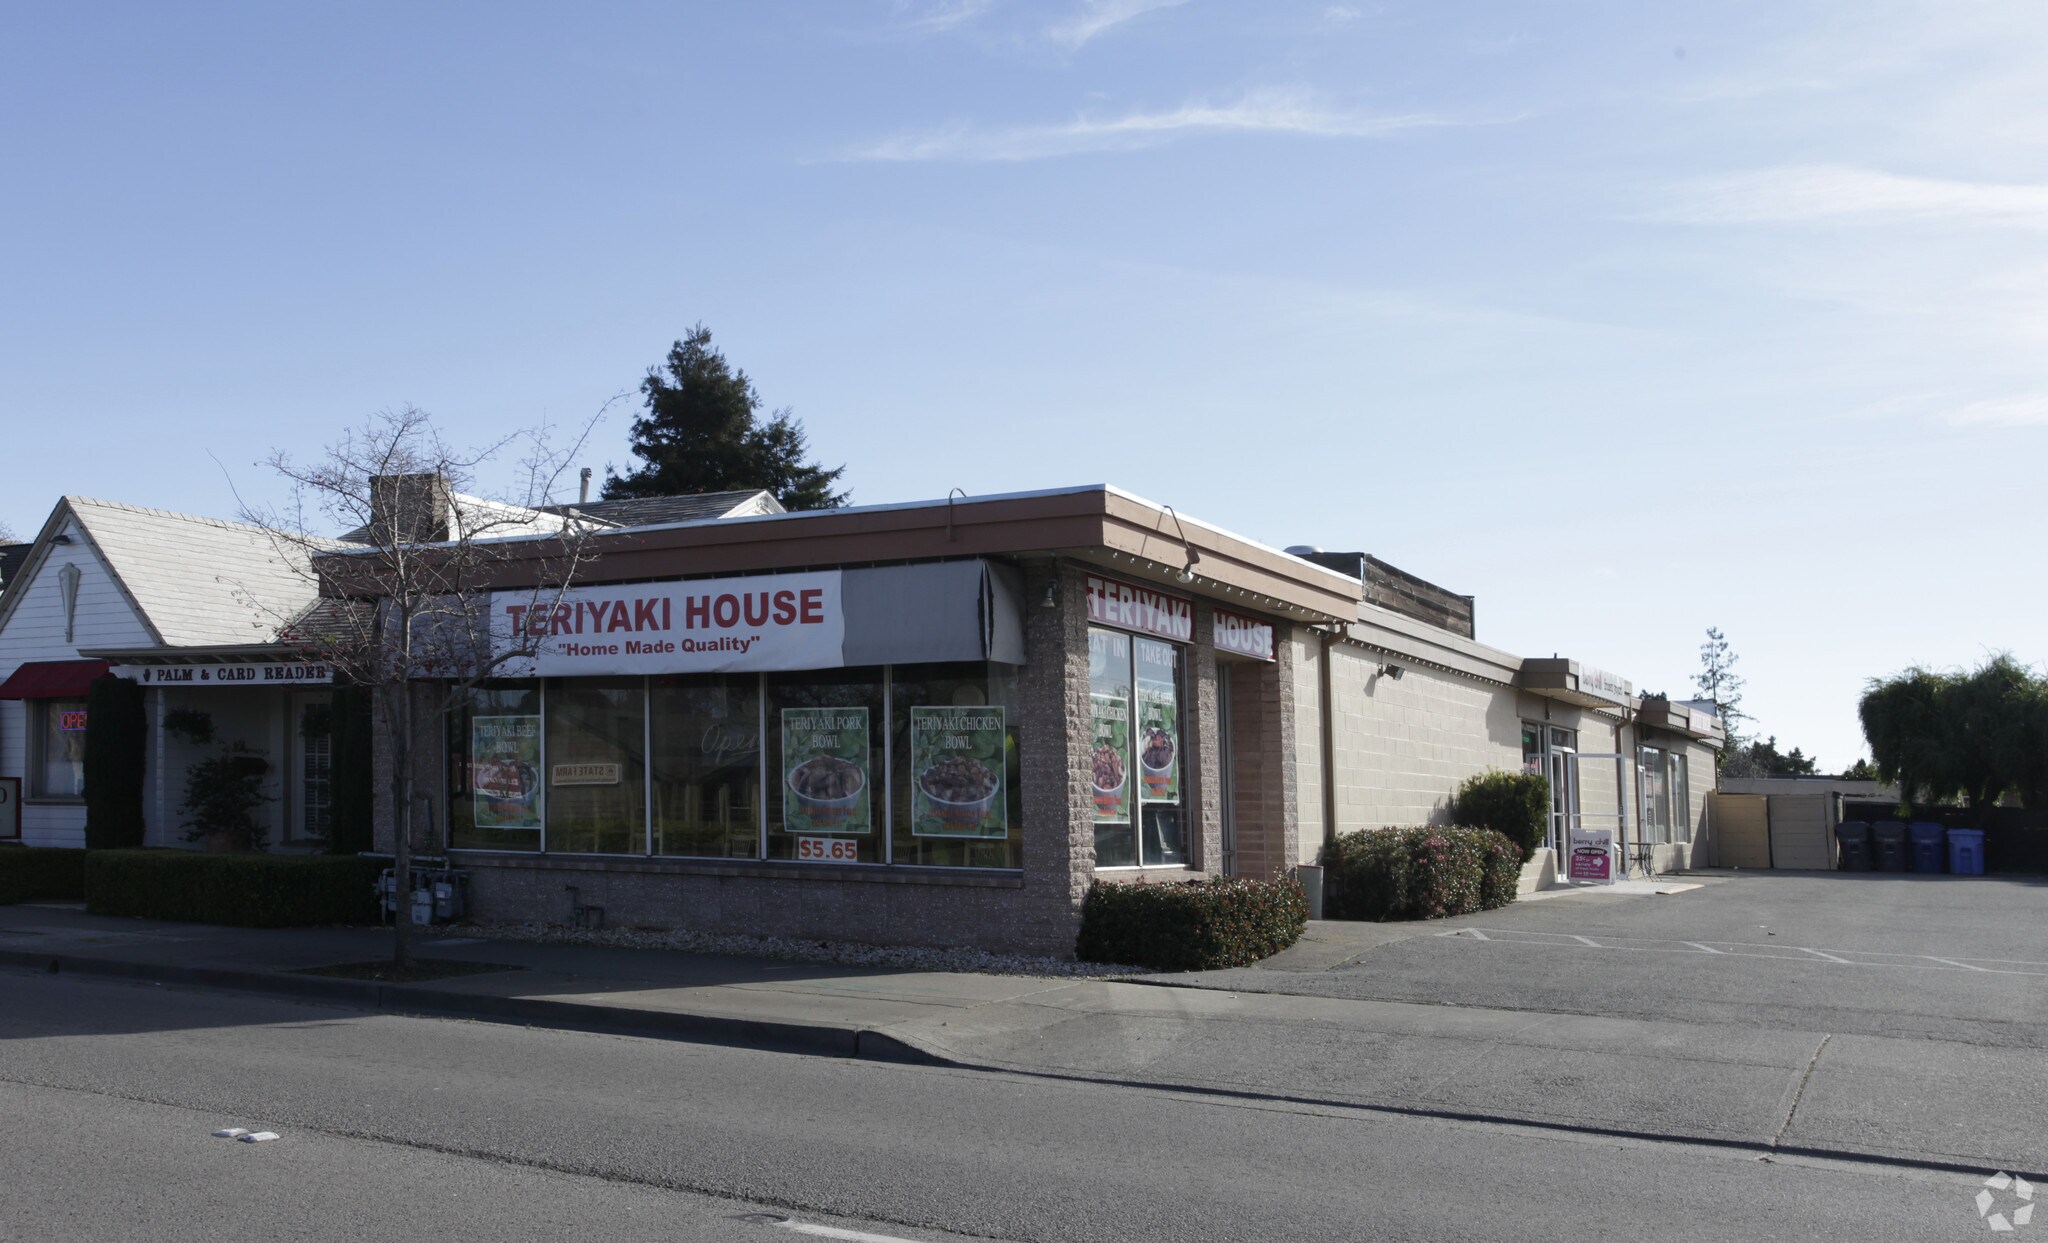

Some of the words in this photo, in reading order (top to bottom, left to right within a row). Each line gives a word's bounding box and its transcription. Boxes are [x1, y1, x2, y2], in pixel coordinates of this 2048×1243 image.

[505, 597, 671, 637] TERIYAKI
[685, 588, 825, 629] HOUSE
[1087, 577, 1192, 641] TERIYAKI
[1213, 611, 1273, 654] HOUSE
[558, 642, 619, 657] "Home
[626, 640, 675, 655] Made
[681, 636, 761, 654] Quality"
[1113, 637, 1125, 659] IN
[1140, 643, 1161, 665] TAKE
[1162, 648, 1177, 669] OUT
[157, 668, 194, 682] PALM
[201, 668, 210, 681] &
[217, 667, 255, 681] CARD
[263, 665, 326, 680] READER
[479, 724, 515, 737] TERIYAKI
[517, 725, 537, 737] BEEF
[790, 716, 836, 730] TERIYAKI
[837, 716, 862, 730] PORK
[916, 716, 959, 730] TERIYAKI
[960, 716, 1001, 730] CHICKEN
[496, 741, 520, 754] BOWL
[812, 735, 841, 748] BOWL
[945, 736, 972, 749] BOWL
[800, 838, 857, 860] $5.65
